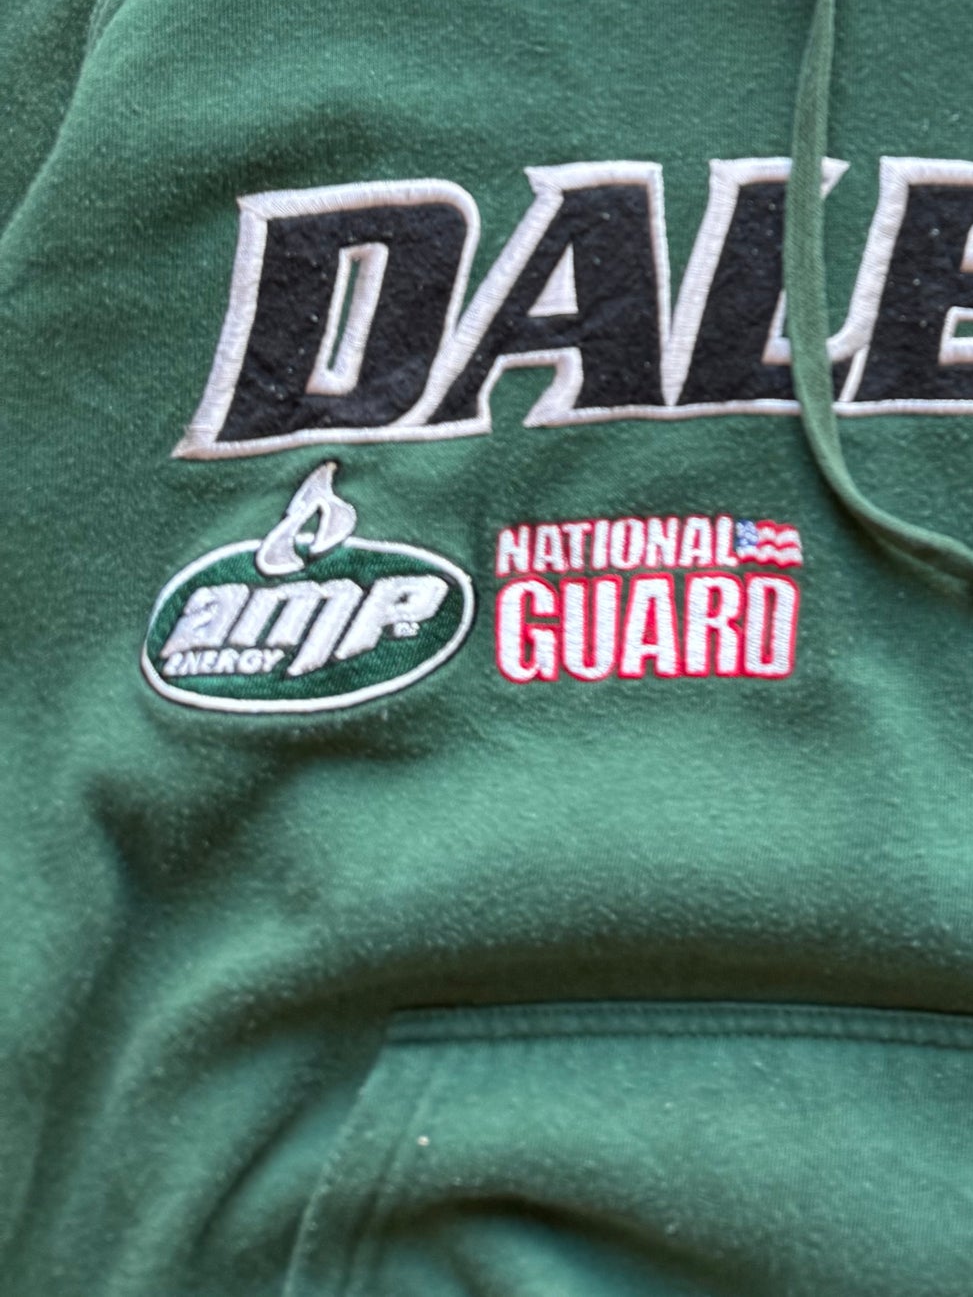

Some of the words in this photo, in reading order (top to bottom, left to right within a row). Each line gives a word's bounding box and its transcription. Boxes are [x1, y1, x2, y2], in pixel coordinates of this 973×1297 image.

[496, 514, 740, 575] NATIONAL
[496, 572, 799, 683] GUARD
[163, 648, 285, 676] ENERGY
